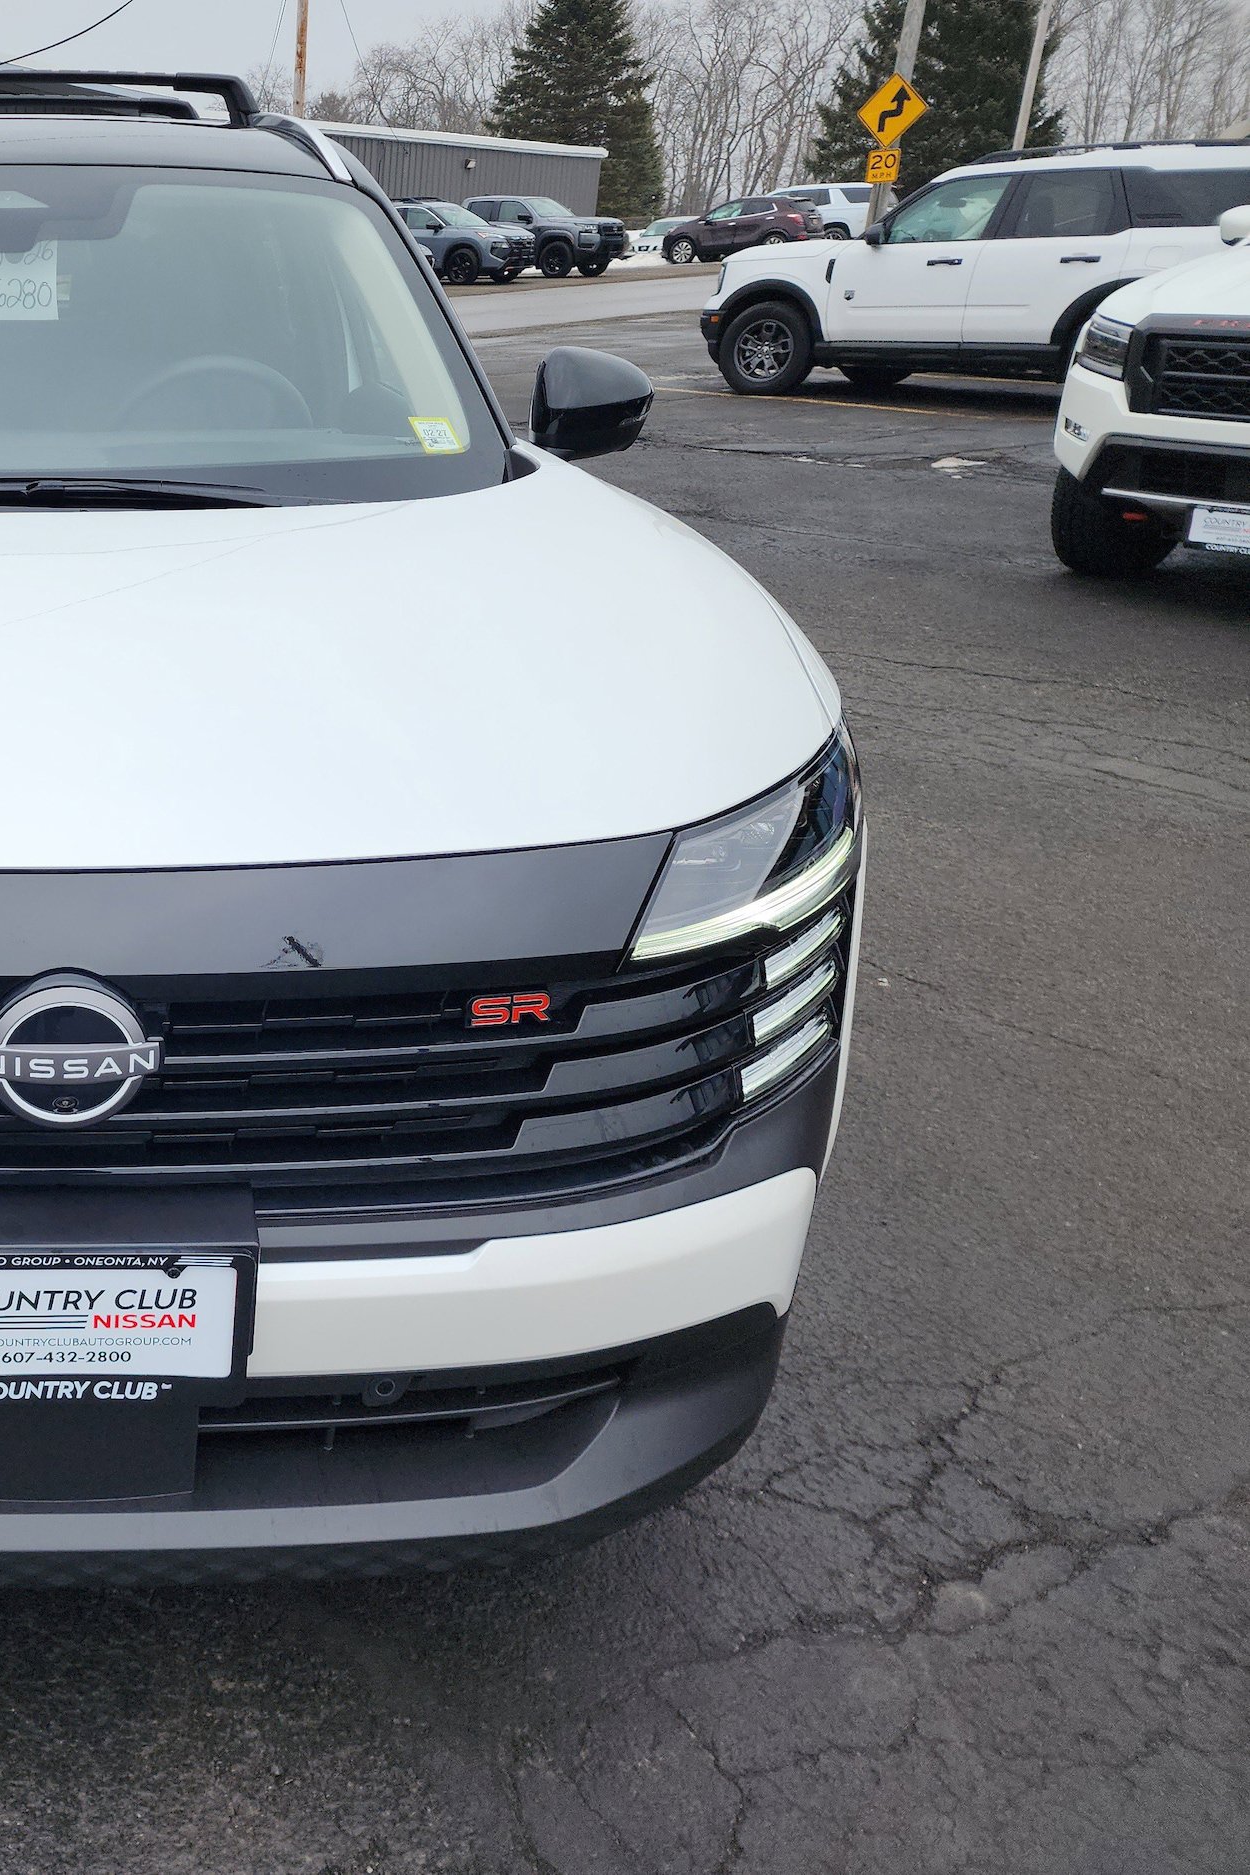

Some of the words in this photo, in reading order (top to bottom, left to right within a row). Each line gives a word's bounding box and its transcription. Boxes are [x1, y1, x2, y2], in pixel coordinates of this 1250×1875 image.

[871, 153, 897, 170] 20
[471, 993, 550, 1026] SR
[11, 1257, 61, 1266] GROUP
[115, 1288, 197, 1310] CLUB
[93, 1314, 196, 1329] NISSAN
[1, 1351, 132, 1364] 607-432-2800
[93, 1380, 159, 1400] CLUB
